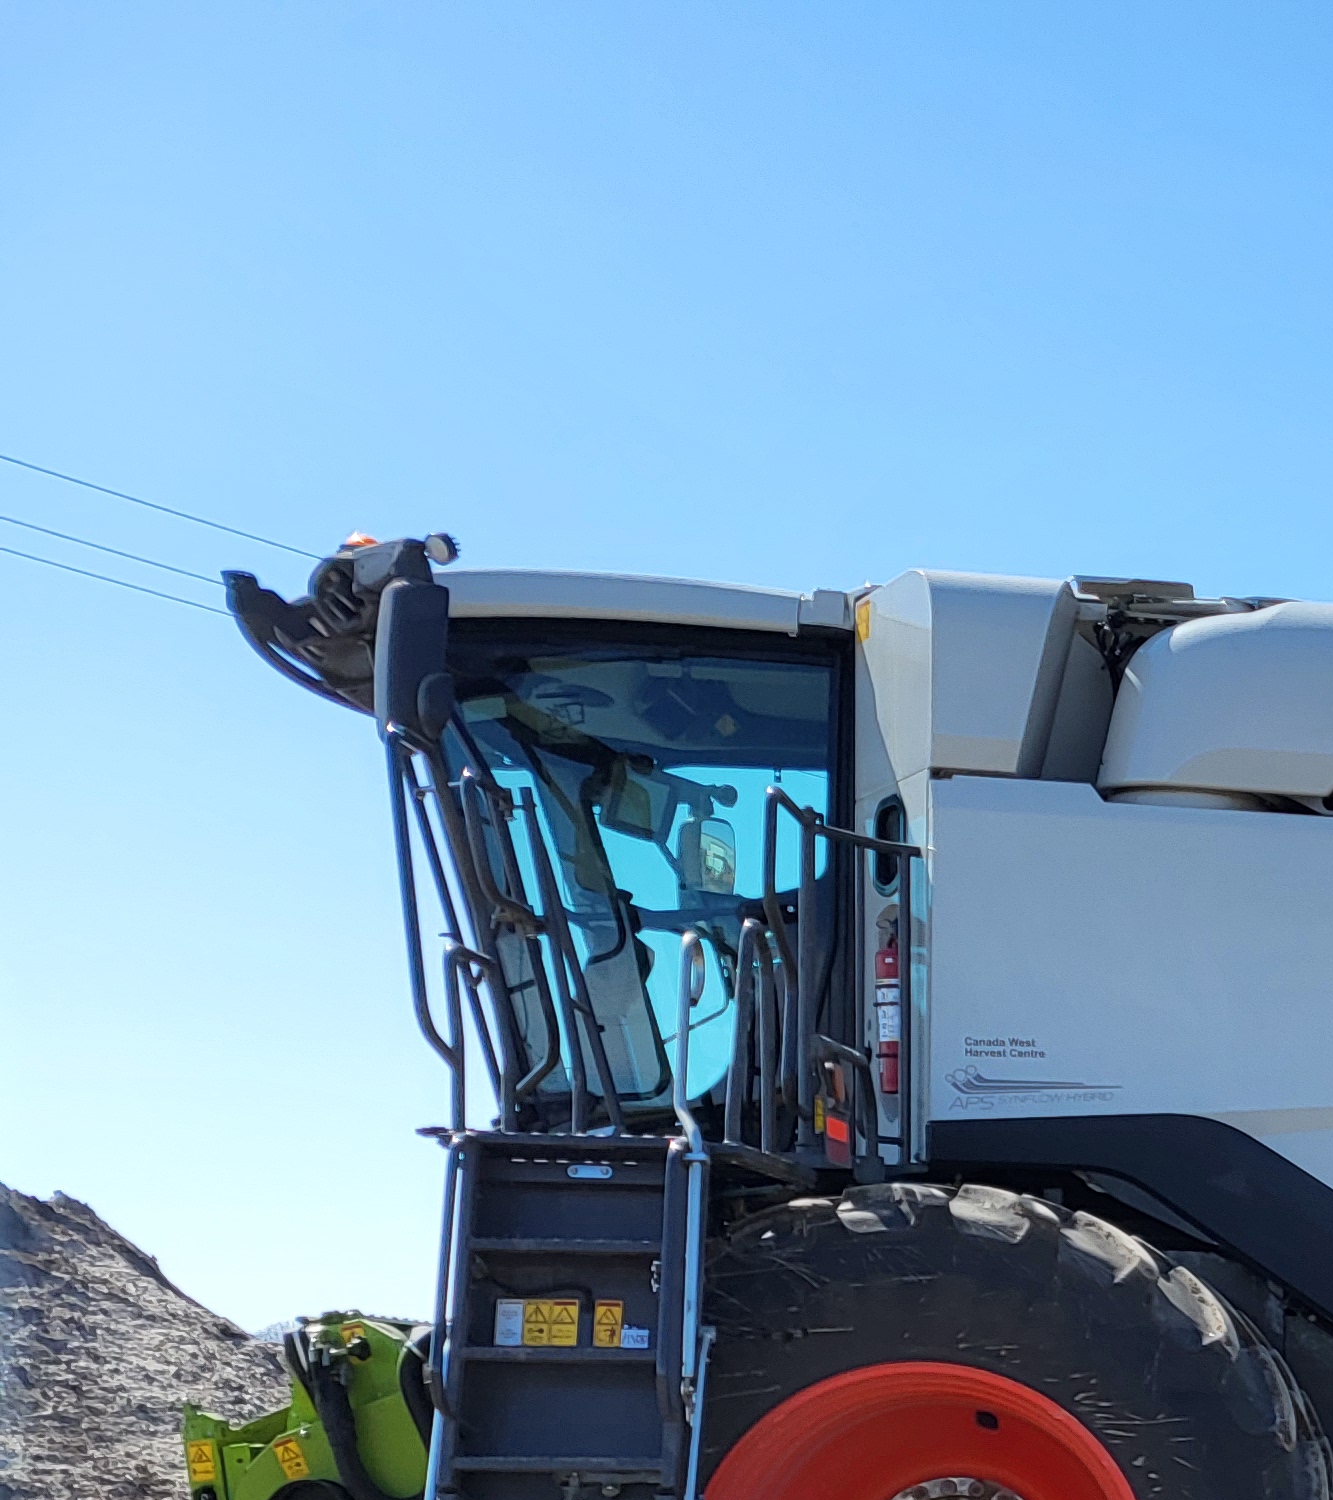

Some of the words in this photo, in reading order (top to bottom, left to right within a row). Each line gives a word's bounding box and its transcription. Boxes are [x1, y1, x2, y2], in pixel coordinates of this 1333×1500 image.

[964, 1036, 1006, 1047] Canada
[1008, 1037, 1036, 1047] West
[964, 1048, 1007, 1058] Harvest
[1009, 1048, 1046, 1058] Centre
[948, 1096, 995, 1111] APS
